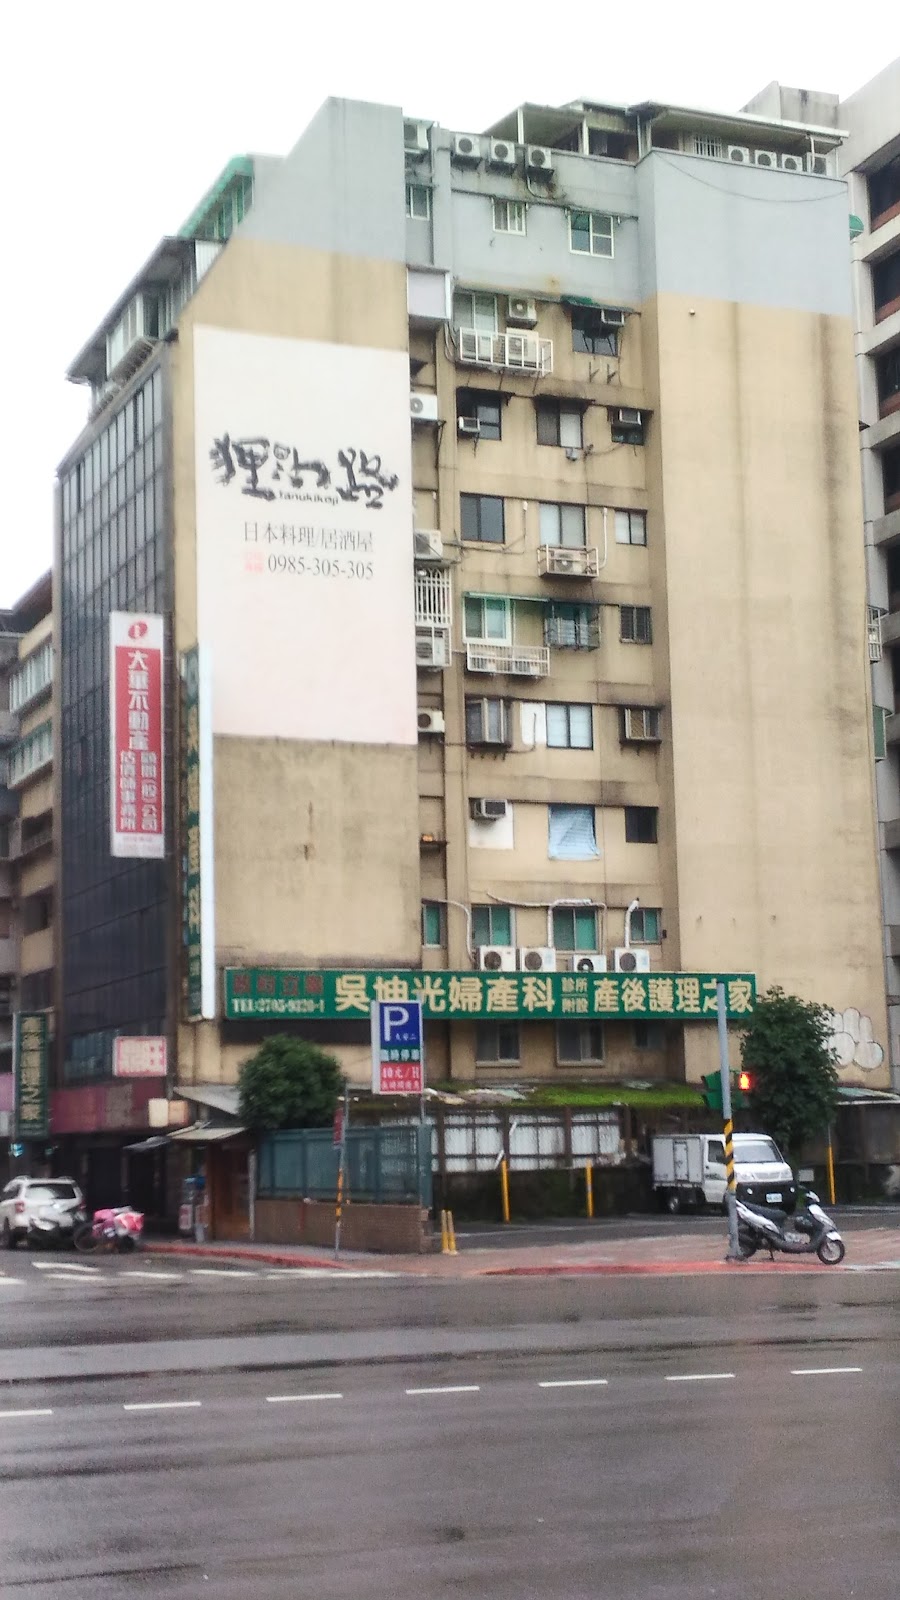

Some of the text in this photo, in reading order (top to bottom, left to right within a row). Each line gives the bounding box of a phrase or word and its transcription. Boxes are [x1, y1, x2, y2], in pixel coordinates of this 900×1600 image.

[244, 521, 373, 552] 日本料理/居酒屋
[267, 552, 374, 580] 0985-305-305
[593, 977, 754, 1014] 產後護理之家
[383, 1006, 409, 1042] P
